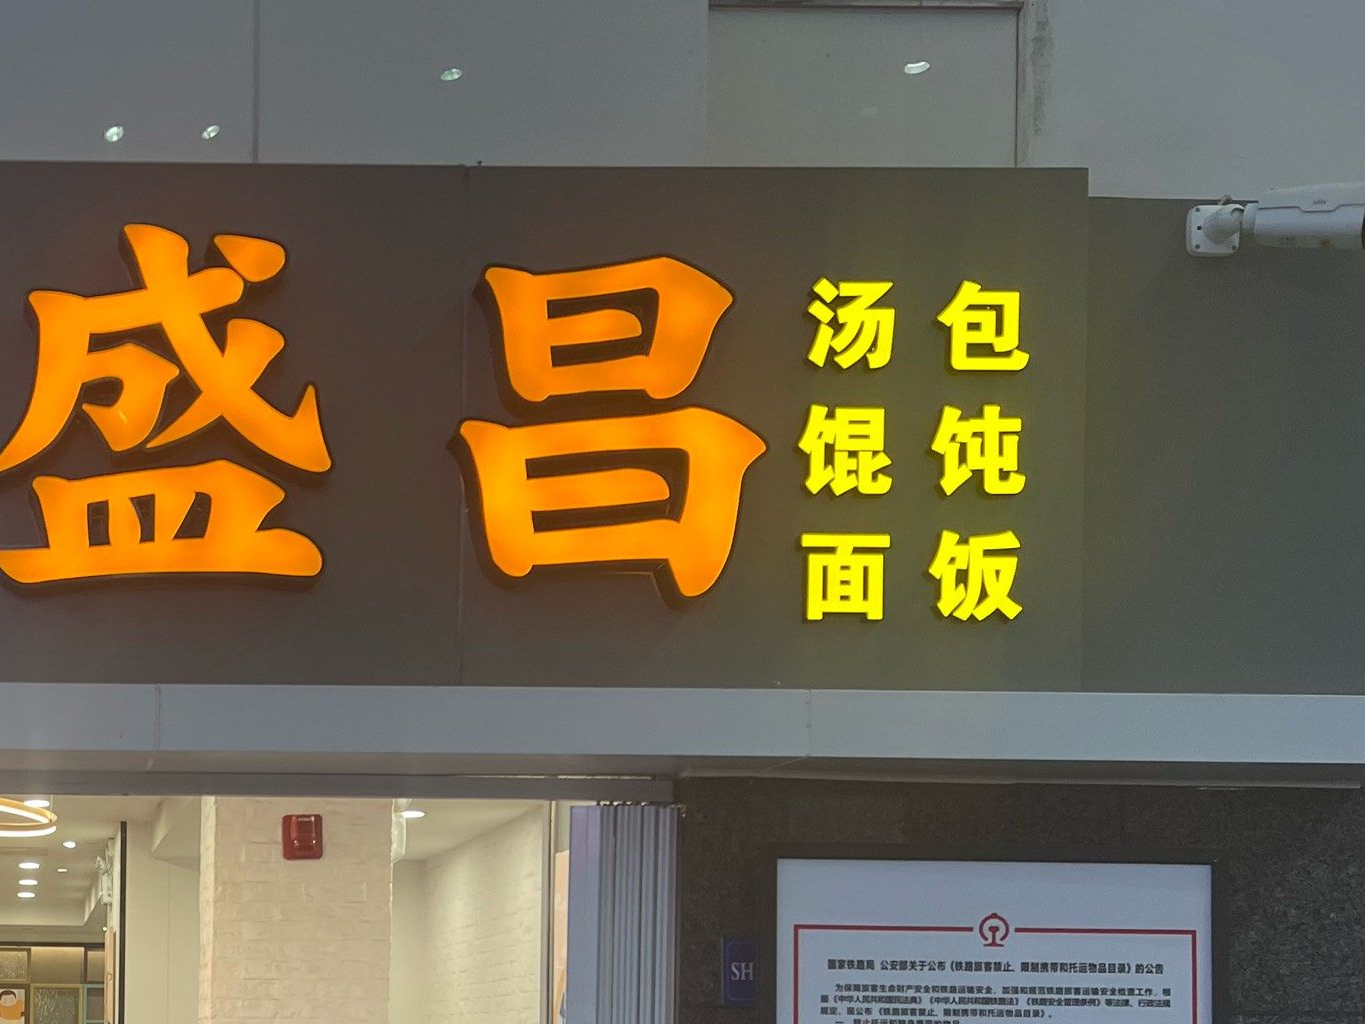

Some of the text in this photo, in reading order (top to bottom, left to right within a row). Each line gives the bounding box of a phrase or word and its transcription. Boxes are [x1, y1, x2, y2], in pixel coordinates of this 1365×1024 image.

[730, 961, 755, 981] SH
[827, 958, 875, 971] 国家铁路局
